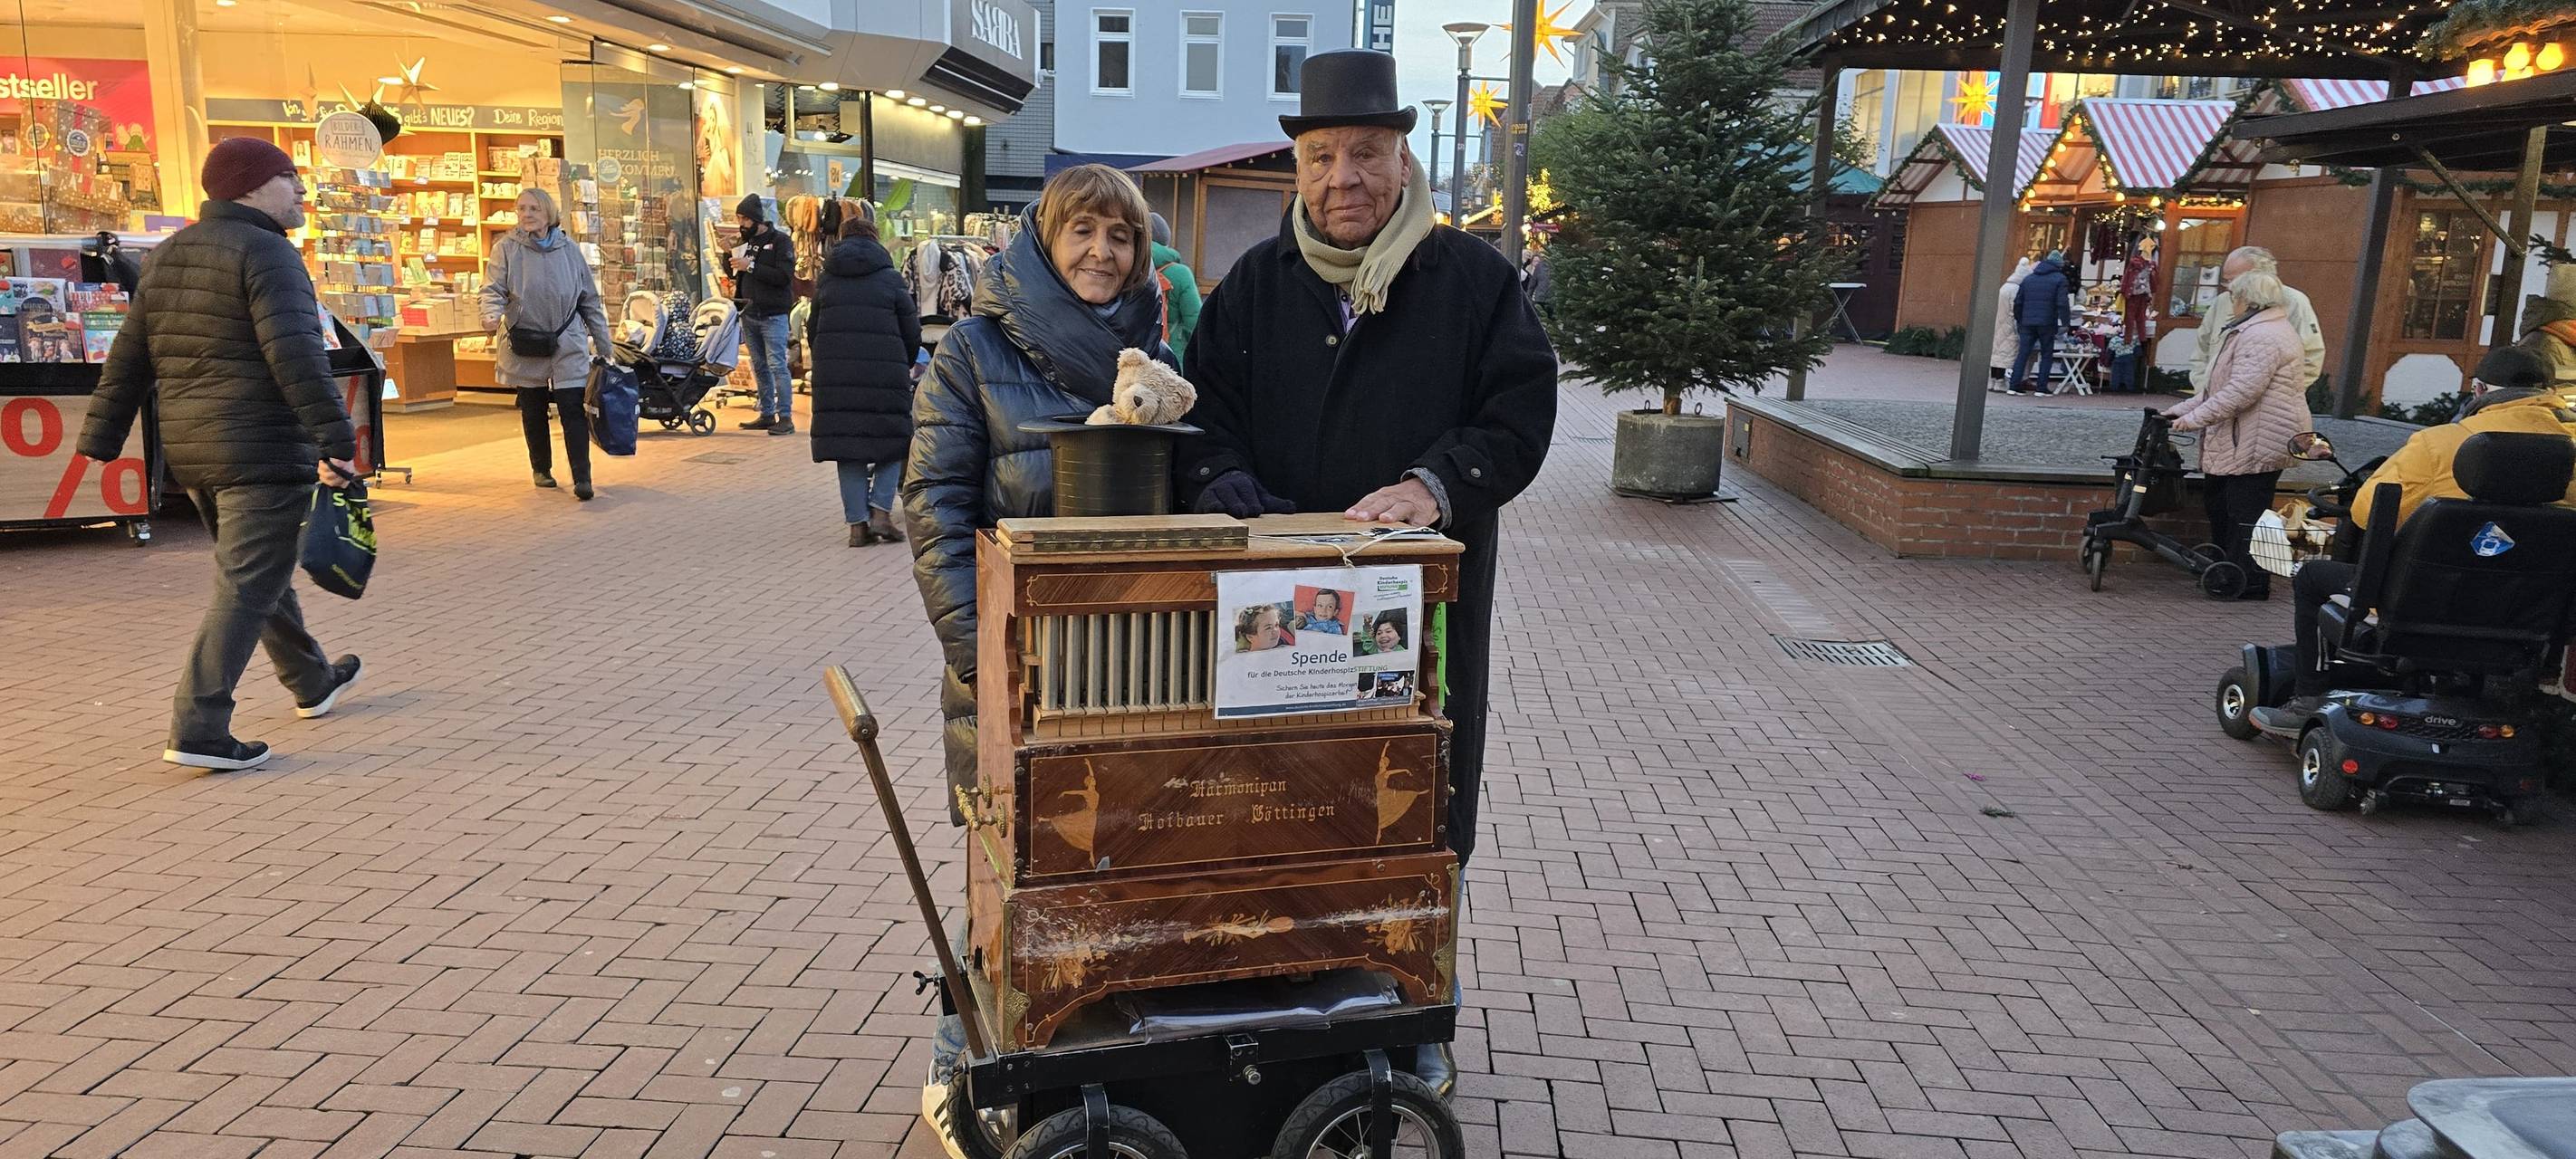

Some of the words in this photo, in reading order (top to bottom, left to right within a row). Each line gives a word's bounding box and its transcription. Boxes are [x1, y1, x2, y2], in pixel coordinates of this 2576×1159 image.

[430, 106, 476, 128] NEUES?
[494, 109, 523, 125] Deine
[528, 108, 563, 130] Region
[598, 148, 659, 161] HERZLICH
[1292, 649, 1347, 667] Spende
[1247, 670, 1259, 678] für
[1261, 670, 1272, 678] die
[1274, 667, 1307, 677] Deutsche
[2425, 715, 2456, 725] drive
[1189, 777, 1287, 798] Harmonipan
[1138, 811, 1224, 831] Hofbauer
